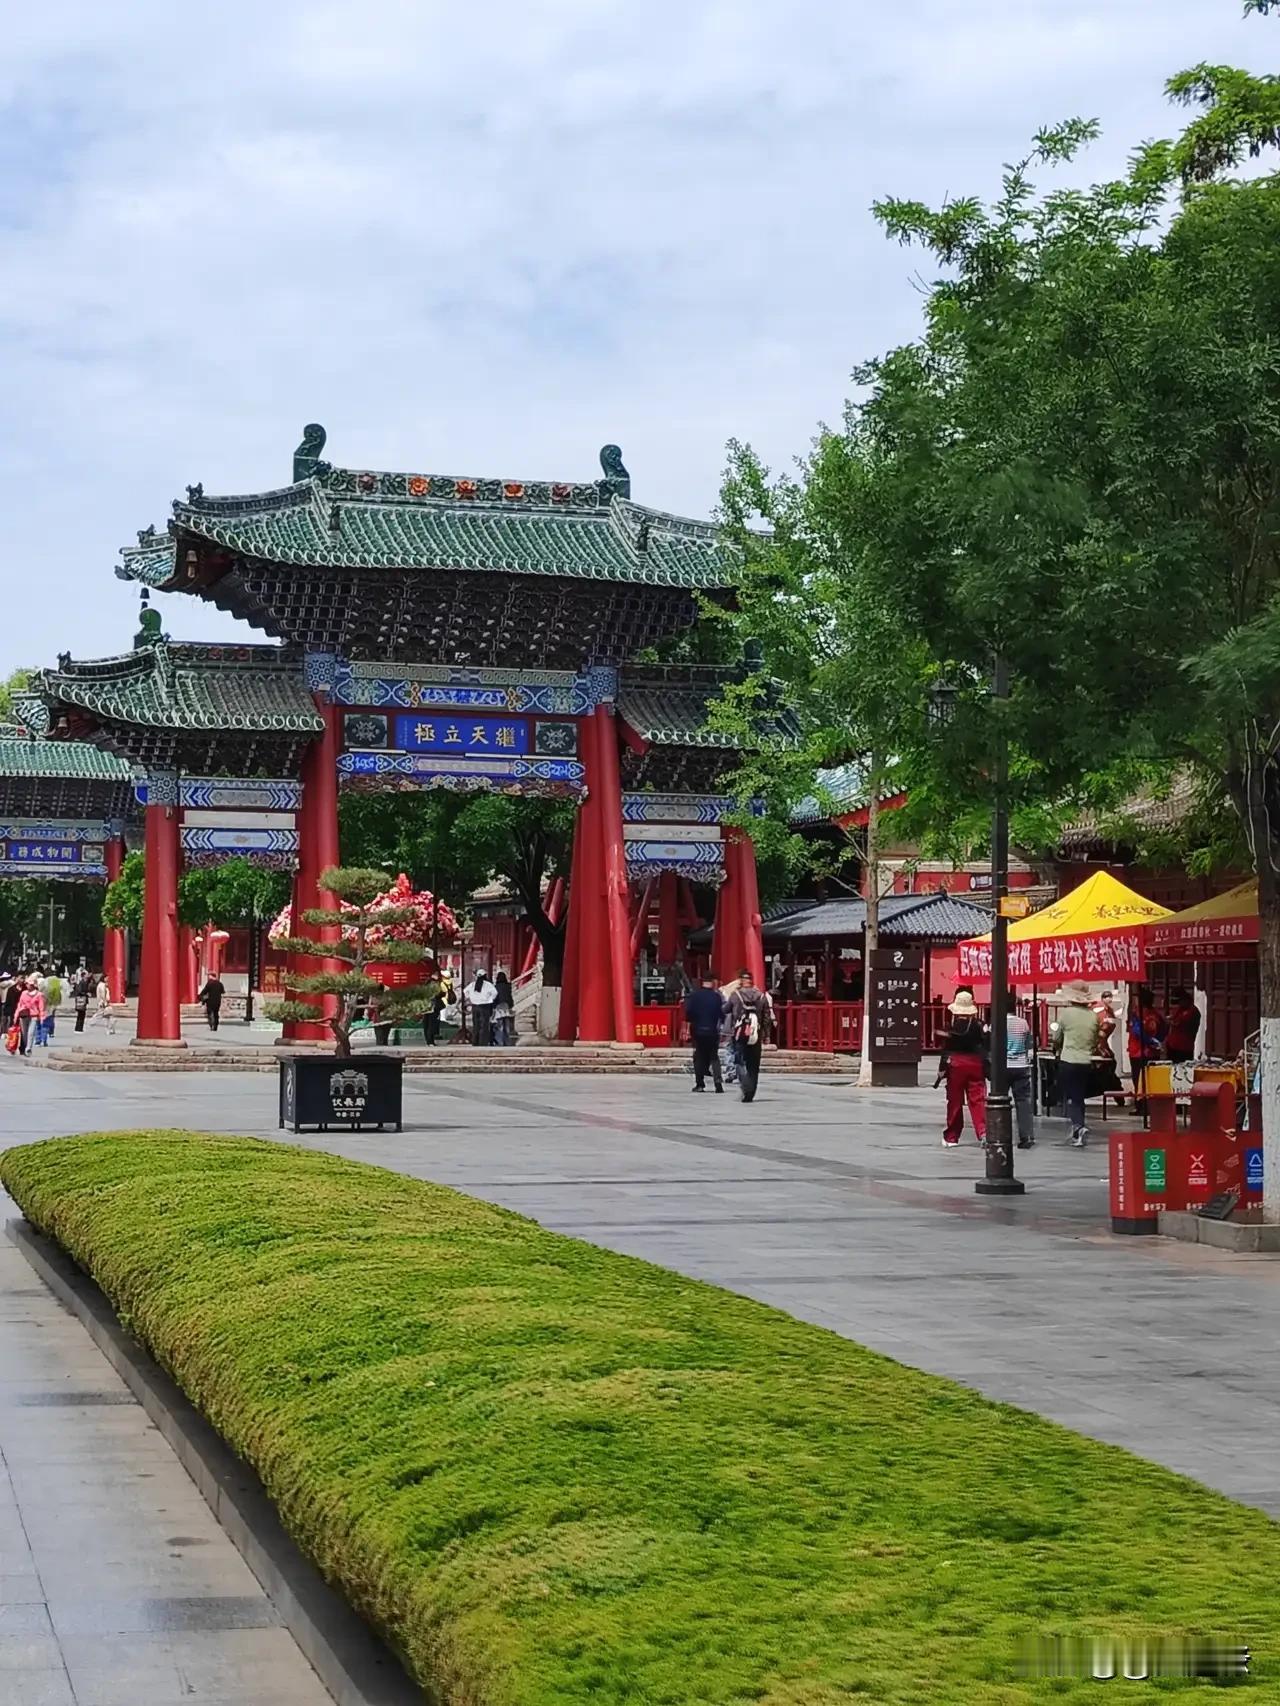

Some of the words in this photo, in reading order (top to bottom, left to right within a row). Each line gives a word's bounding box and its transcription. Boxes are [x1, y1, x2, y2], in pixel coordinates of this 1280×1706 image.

[1039, 935, 1140, 974] 垃圾分类新时尚
